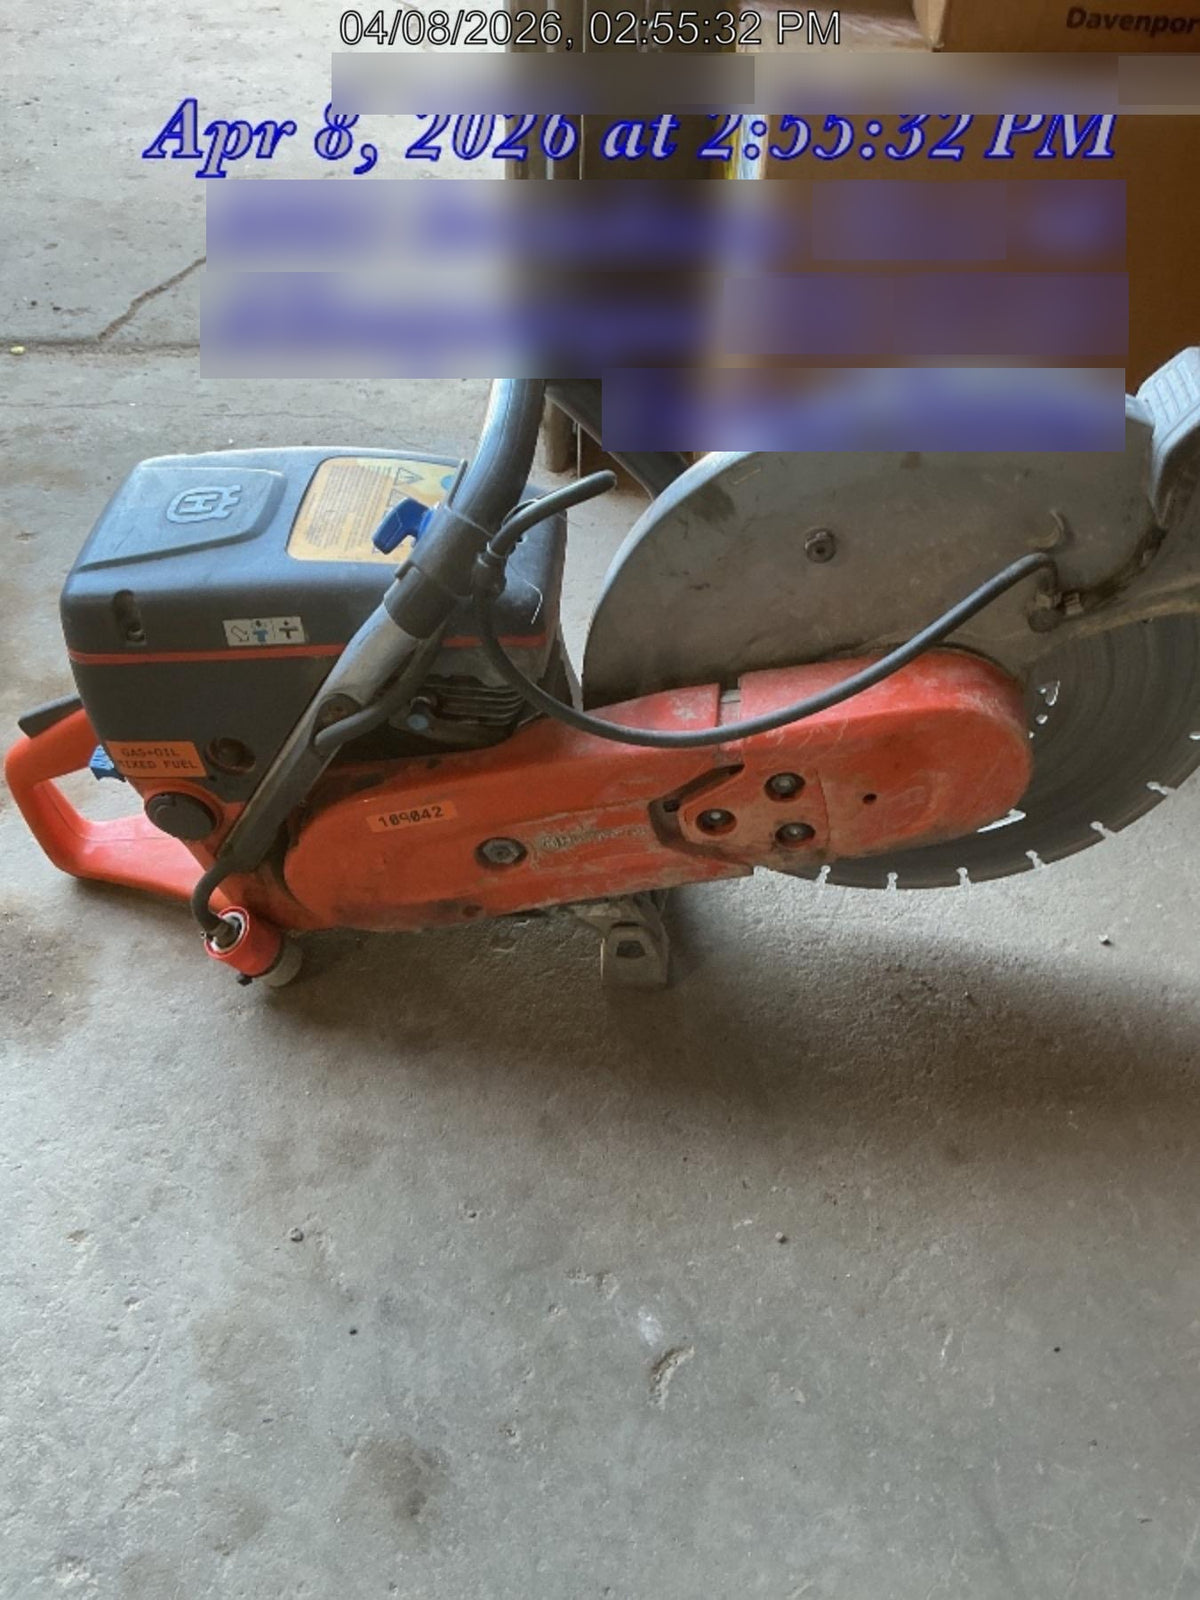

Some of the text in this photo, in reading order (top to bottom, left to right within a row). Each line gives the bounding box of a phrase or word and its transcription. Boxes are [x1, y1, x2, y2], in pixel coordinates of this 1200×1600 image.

[1065, 6, 1200, 38] Davenpor
[163, 759, 199, 770] FUEL
[378, 804, 444, 828] 109042
